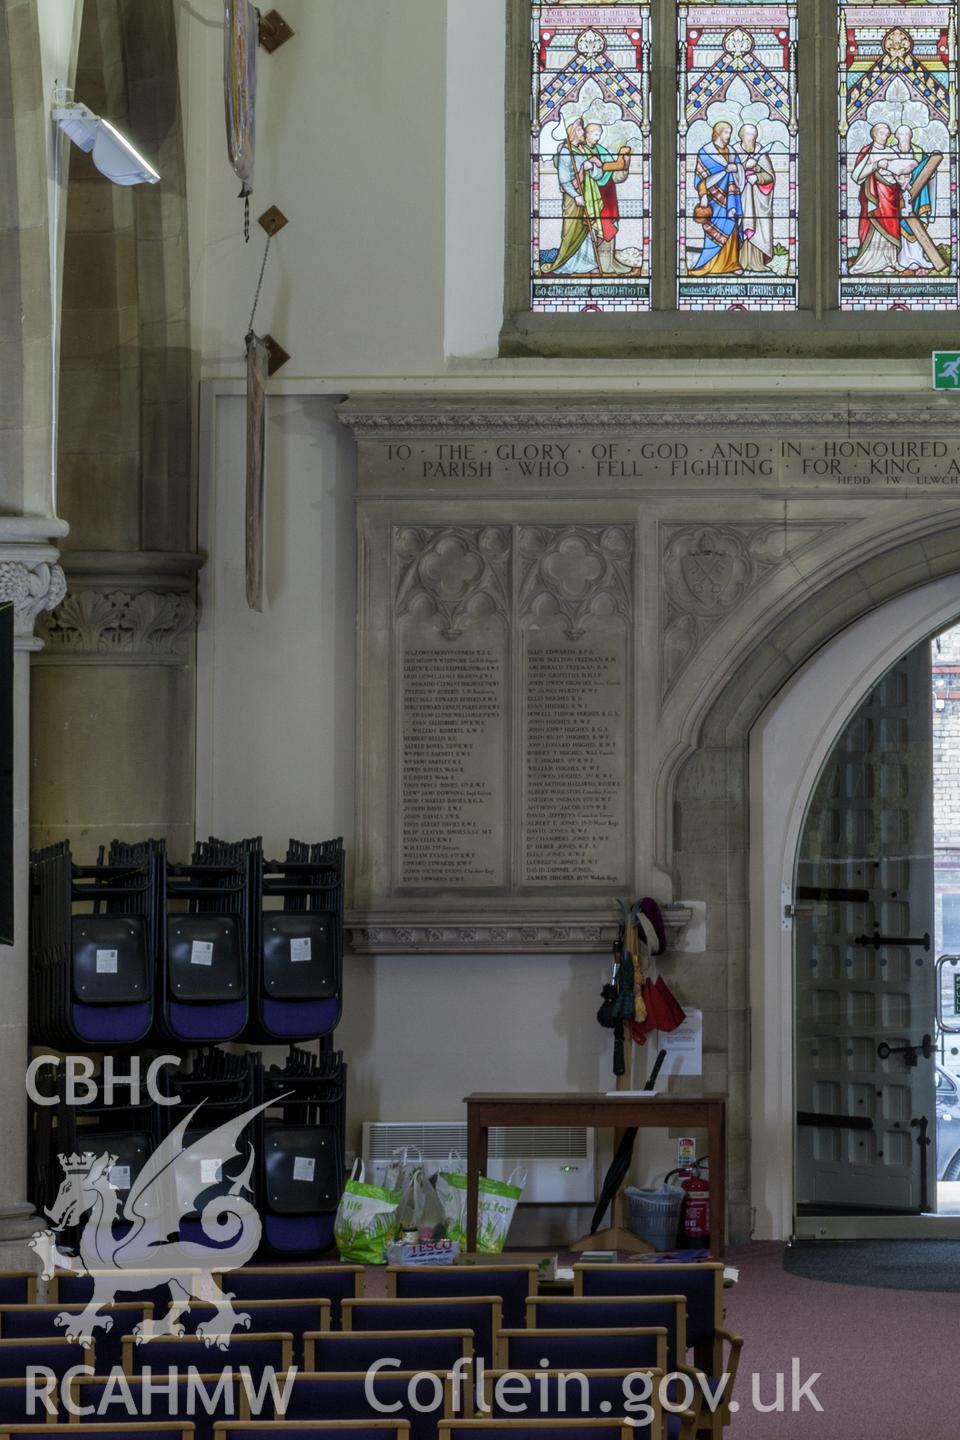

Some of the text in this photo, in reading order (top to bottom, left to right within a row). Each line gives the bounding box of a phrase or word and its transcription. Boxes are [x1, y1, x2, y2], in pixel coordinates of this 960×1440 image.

[384, 445, 412, 460] TO
[435, 445, 475, 460] THE
[497, 444, 570, 459] GLORY
[591, 444, 619, 459] OF
[640, 444, 689, 459] GOD
[712, 443, 759, 458] AND
[781, 443, 802, 458] IN
[824, 442, 948, 457] HONOURED
[422, 462, 492, 477] PARISH
[518, 461, 569, 477] WHO
[596, 461, 643, 476] FELL
[671, 460, 773, 476] FIGHTING
[802, 460, 841, 475] FOR
[869, 459, 921, 475] KING
[917, 476, 959, 485] LLWCH
[410, 1241, 453, 1254] TESCO
